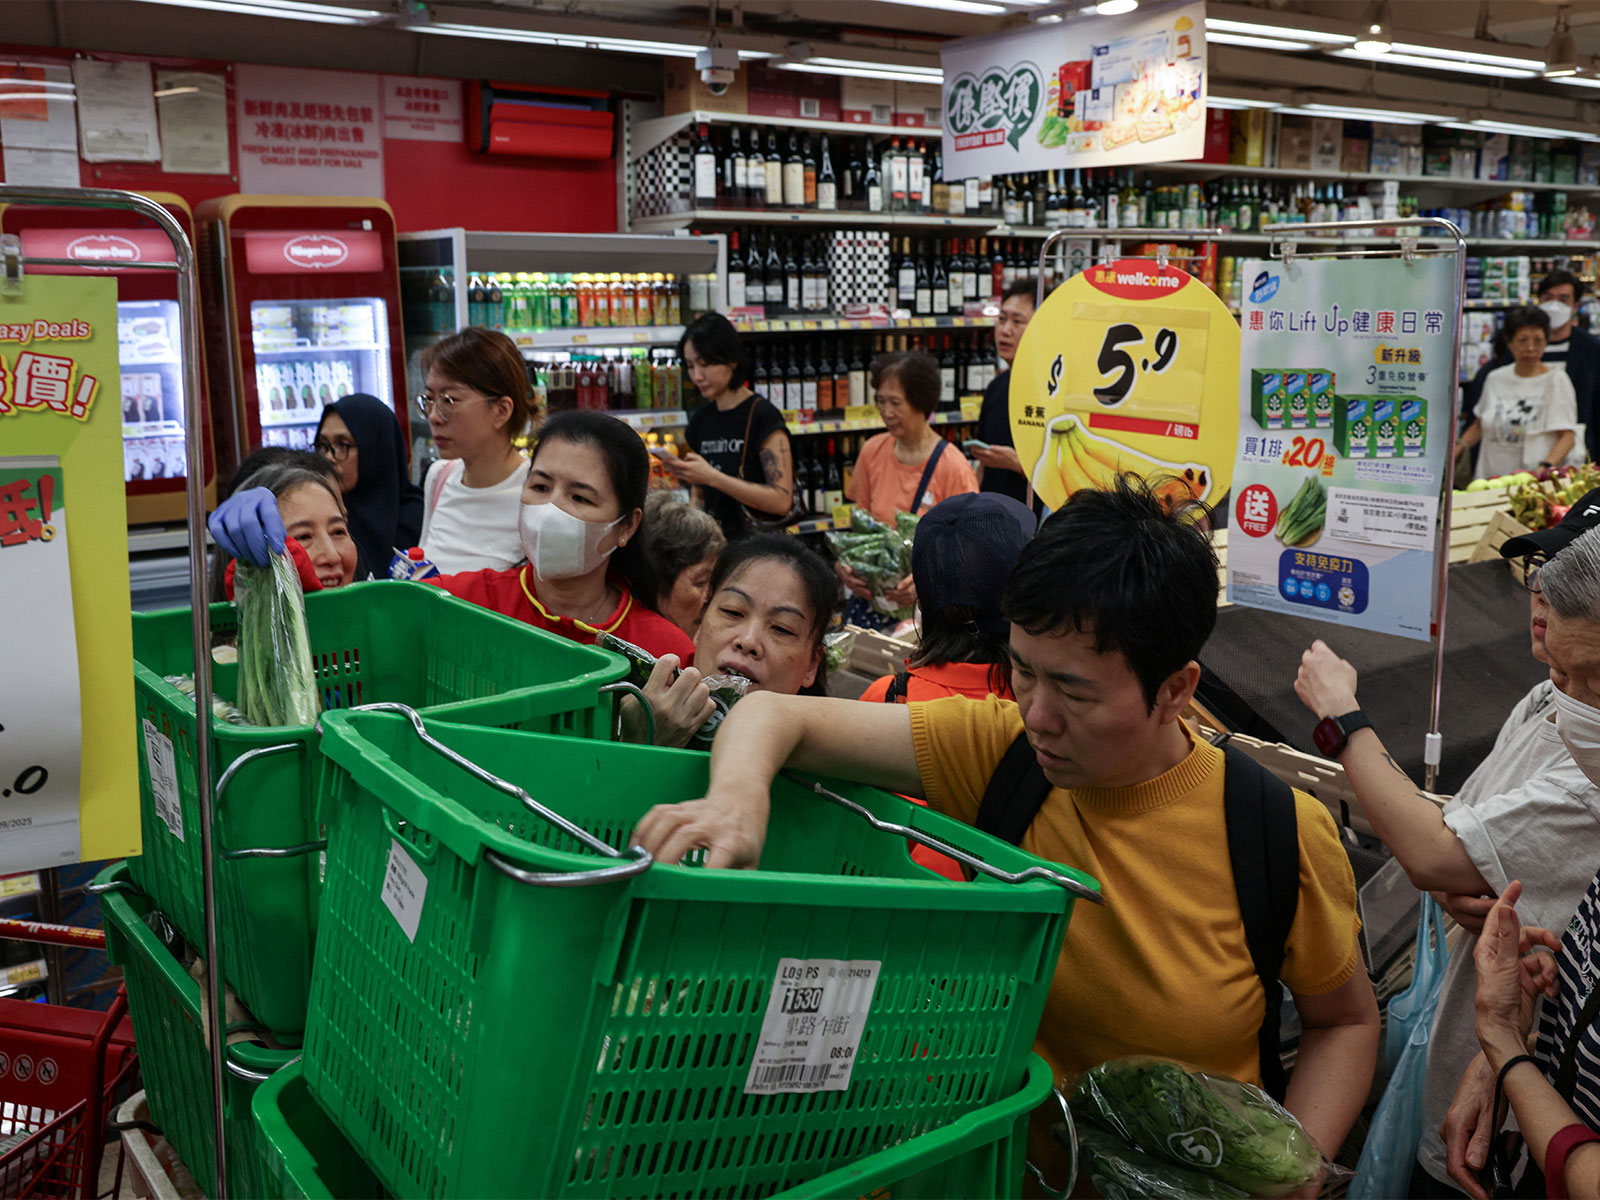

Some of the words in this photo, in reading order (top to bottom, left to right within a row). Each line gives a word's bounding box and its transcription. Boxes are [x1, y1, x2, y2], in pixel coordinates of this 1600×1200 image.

[242, 144, 270, 154] FRESH
[271, 145, 296, 155] MEAT
[298, 147, 318, 156] AND
[260, 156, 297, 166] CHILLED
[298, 157, 322, 167] MEAT
[324, 158, 341, 168] FOR
[343, 158, 363, 168] SALE
[1117, 272, 1179, 289] wellcome
[34, 318, 90, 338] Deals
[1289, 311, 1317, 331] Lift
[1047, 354, 1062, 396] $
[1092, 323, 1177, 407] 5.9
[0, 351, 96, 418] 價!
[1024, 405, 1046, 419] 香蕉
[1018, 420, 1045, 428] BANANA
[1243, 489, 1270, 522] 送
[1243, 521, 1268, 533] FREE
[1295, 552, 1353, 574] 支持免疫力
[805, 966, 819, 979] PS
[785, 988, 824, 1012] 1530
